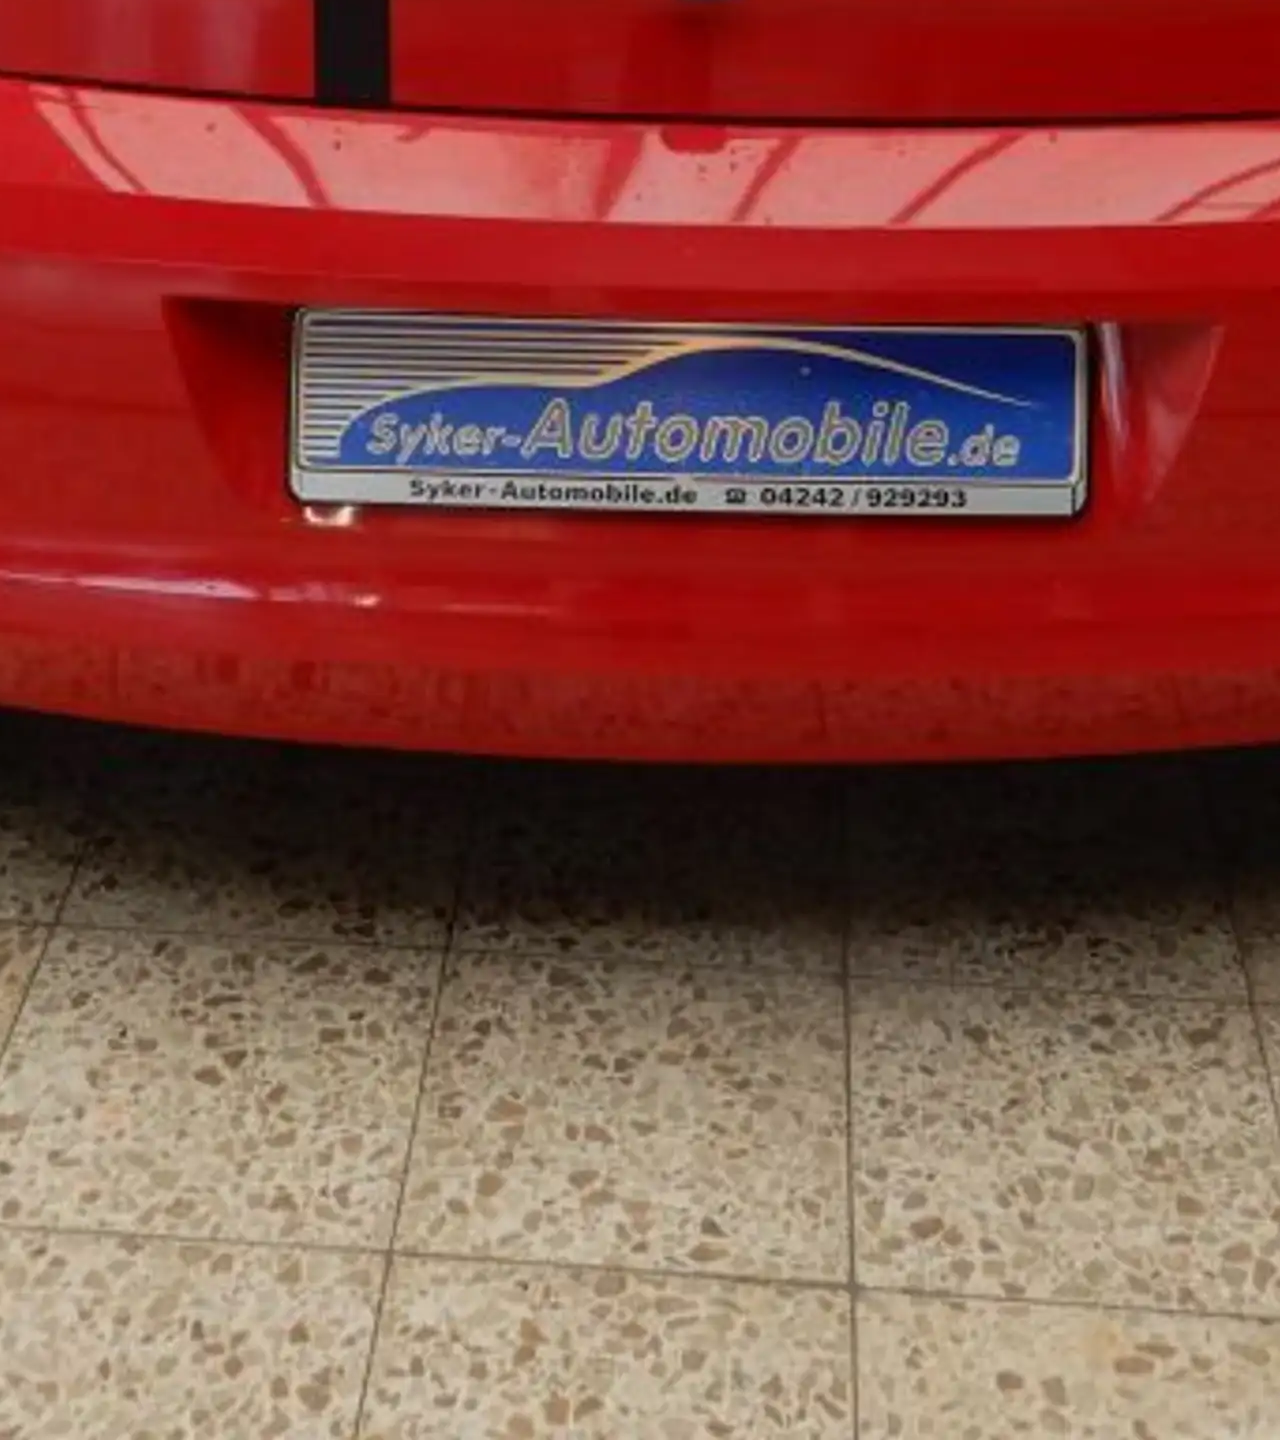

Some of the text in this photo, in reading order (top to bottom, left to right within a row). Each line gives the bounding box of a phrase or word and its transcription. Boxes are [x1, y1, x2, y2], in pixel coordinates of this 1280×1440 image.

[365, 397, 1021, 466] Syker-Automobile.de
[409, 478, 698, 505] Syker-Automobile.de
[759, 487, 846, 508] 04242
